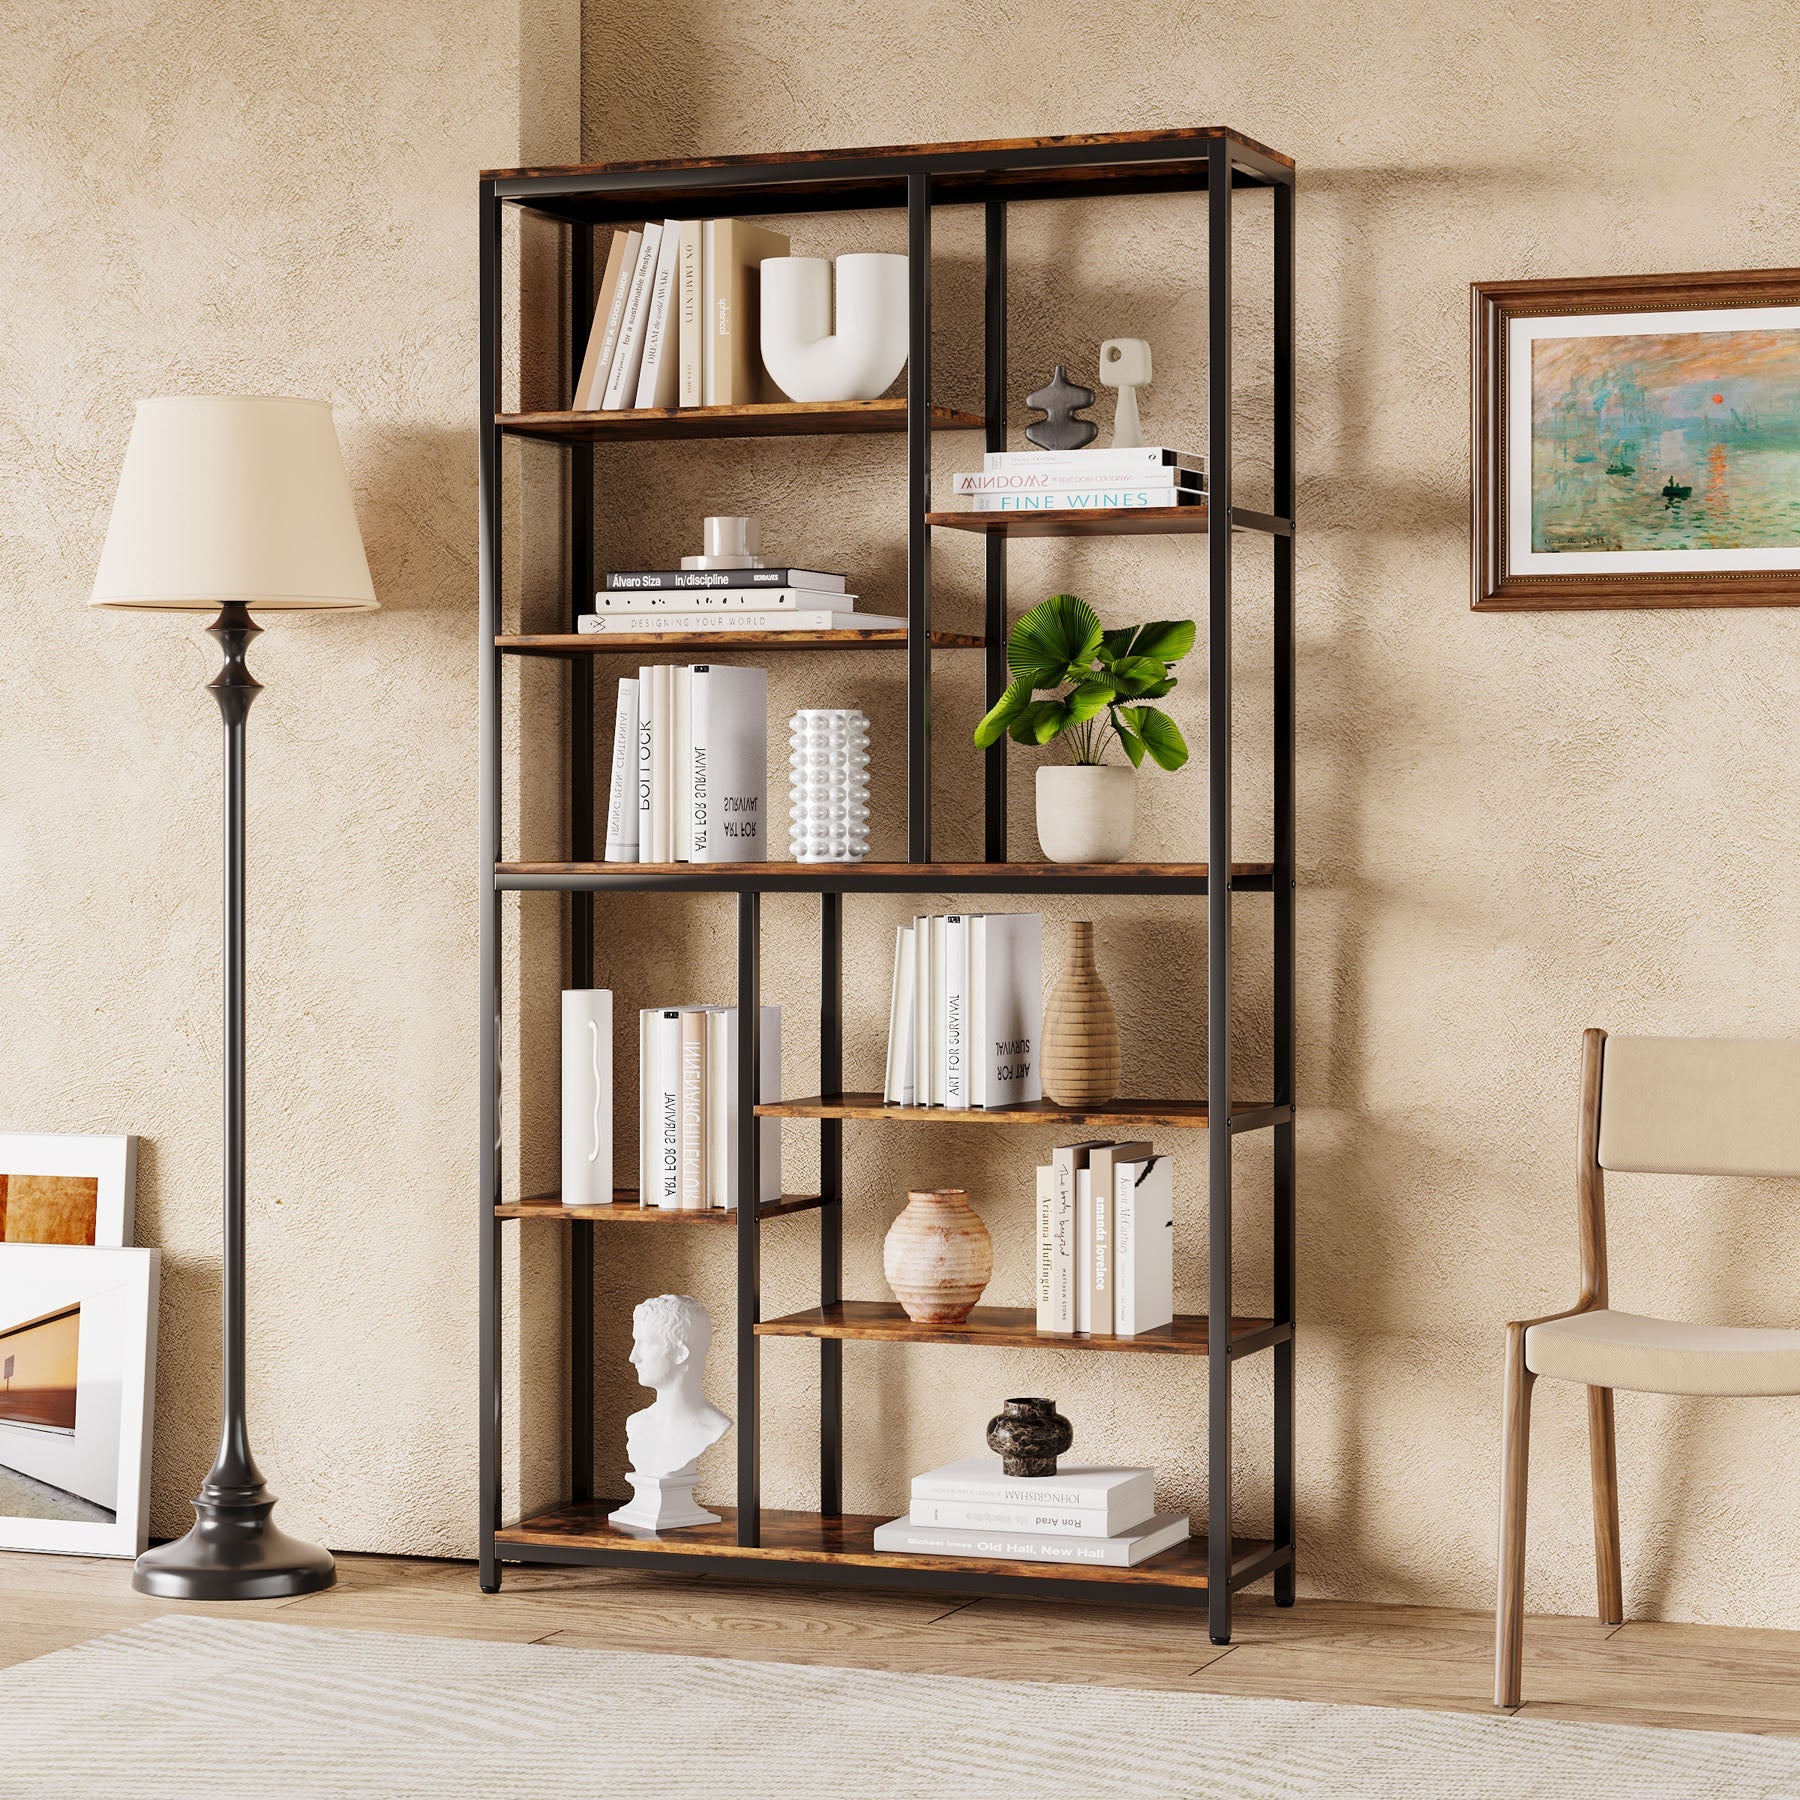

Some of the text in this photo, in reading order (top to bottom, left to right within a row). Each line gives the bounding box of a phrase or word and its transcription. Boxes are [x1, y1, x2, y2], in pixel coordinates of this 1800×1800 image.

[636, 245, 653, 277] lifestyle
[685, 244, 693, 325] ON IMMUNITY
[628, 279, 645, 325] sustainable
[600, 346, 611, 366] THIS
[609, 300, 622, 327] GOOD
[616, 271, 629, 299] GUIDE
[647, 330, 659, 365] DREAM
[658, 268, 669, 302] AWAKE
[718, 298, 730, 335] spherical
[622, 333, 631, 346] for
[1001, 495, 1054, 511] FINE
[1067, 493, 1148, 508] WINES
[612, 573, 640, 587] Álvaro
[642, 575, 661, 587] Siza
[675, 573, 729, 587] In/discipline
[630, 616, 766, 627] DESIGNING YOUR WORLD
[949, 994, 960, 1096] ART FOR SURVIVAL
[996, 1039, 1030, 1056] SURVIVAL
[997, 1063, 1031, 1081] ART FOR
[1119, 1177, 1131, 1205] Karen
[1040, 1196, 1052, 1302] Arianna Huffington
[1095, 1197, 1107, 1291] amanda lovelace
[1035, 1516, 1059, 1526] Arad
[1061, 1518, 1081, 1528] Ron
[907, 1537, 1104, 1558] Michael Innes Old Hall, New Hall
